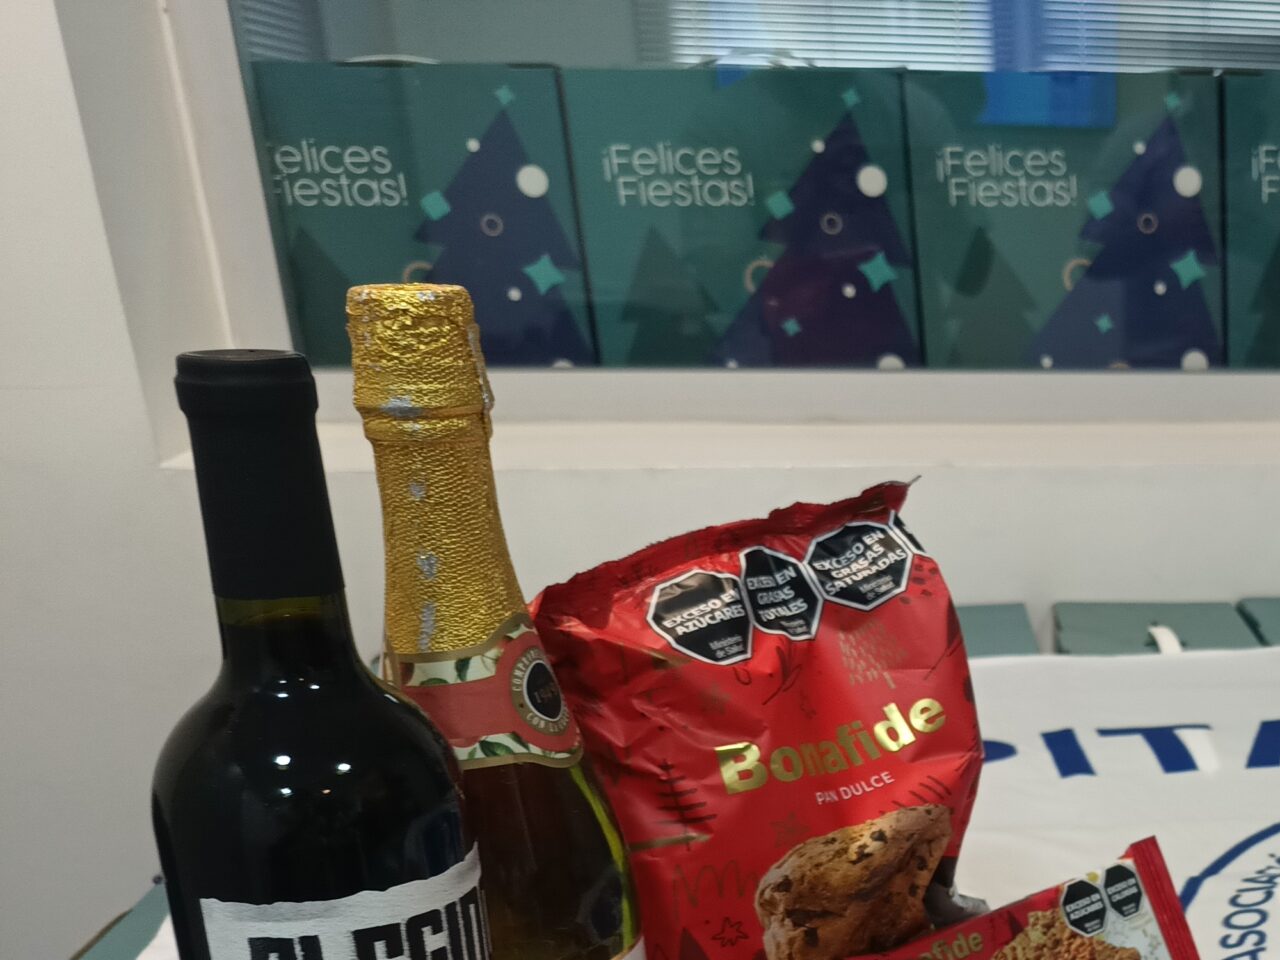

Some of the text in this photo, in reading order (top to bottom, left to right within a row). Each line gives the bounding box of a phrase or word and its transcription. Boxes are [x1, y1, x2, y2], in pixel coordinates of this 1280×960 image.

[268, 138, 393, 176] elices
[603, 141, 742, 182] ¡Felices
[936, 143, 1067, 183] ¡Felices
[617, 174, 755, 208] Fiestas!
[948, 174, 1078, 208] Fiestas!
[813, 531, 885, 572] EXCESO EN
[831, 544, 885, 579] GRASAS
[825, 550, 907, 595] SATURADAS
[662, 597, 722, 628] EXCESO
[715, 697, 947, 796] Bonafide
[839, 772, 895, 802] DULCE
